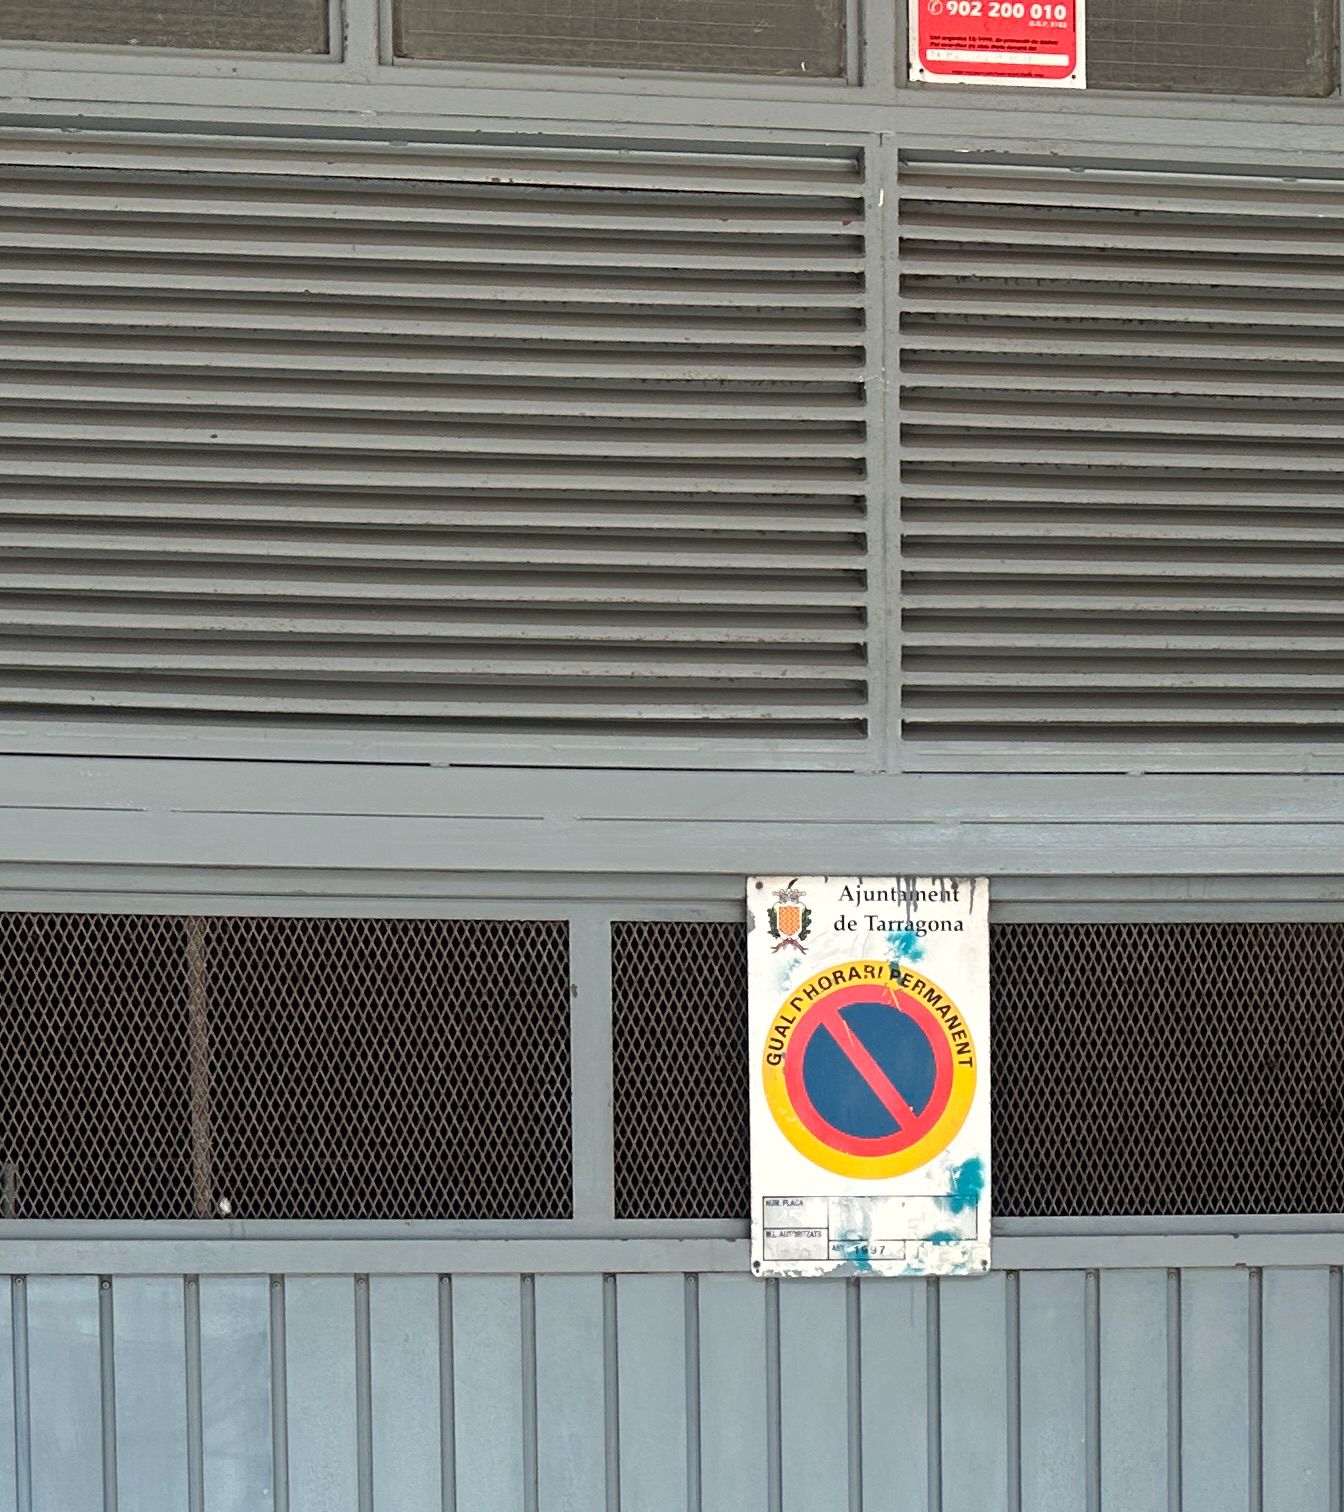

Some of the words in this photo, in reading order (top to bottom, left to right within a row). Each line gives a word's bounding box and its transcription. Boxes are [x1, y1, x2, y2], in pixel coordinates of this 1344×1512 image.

[946, 0, 982, 17] 902
[988, 2, 1025, 19] 200
[1030, 3, 1067, 21] 010
[838, 885, 960, 907] Ajuntament
[834, 914, 858, 932] de
[864, 914, 964, 937] Tarragona
[766, 1014, 797, 1067] GUAL
[889, 967, 973, 1069] PERMANENT
